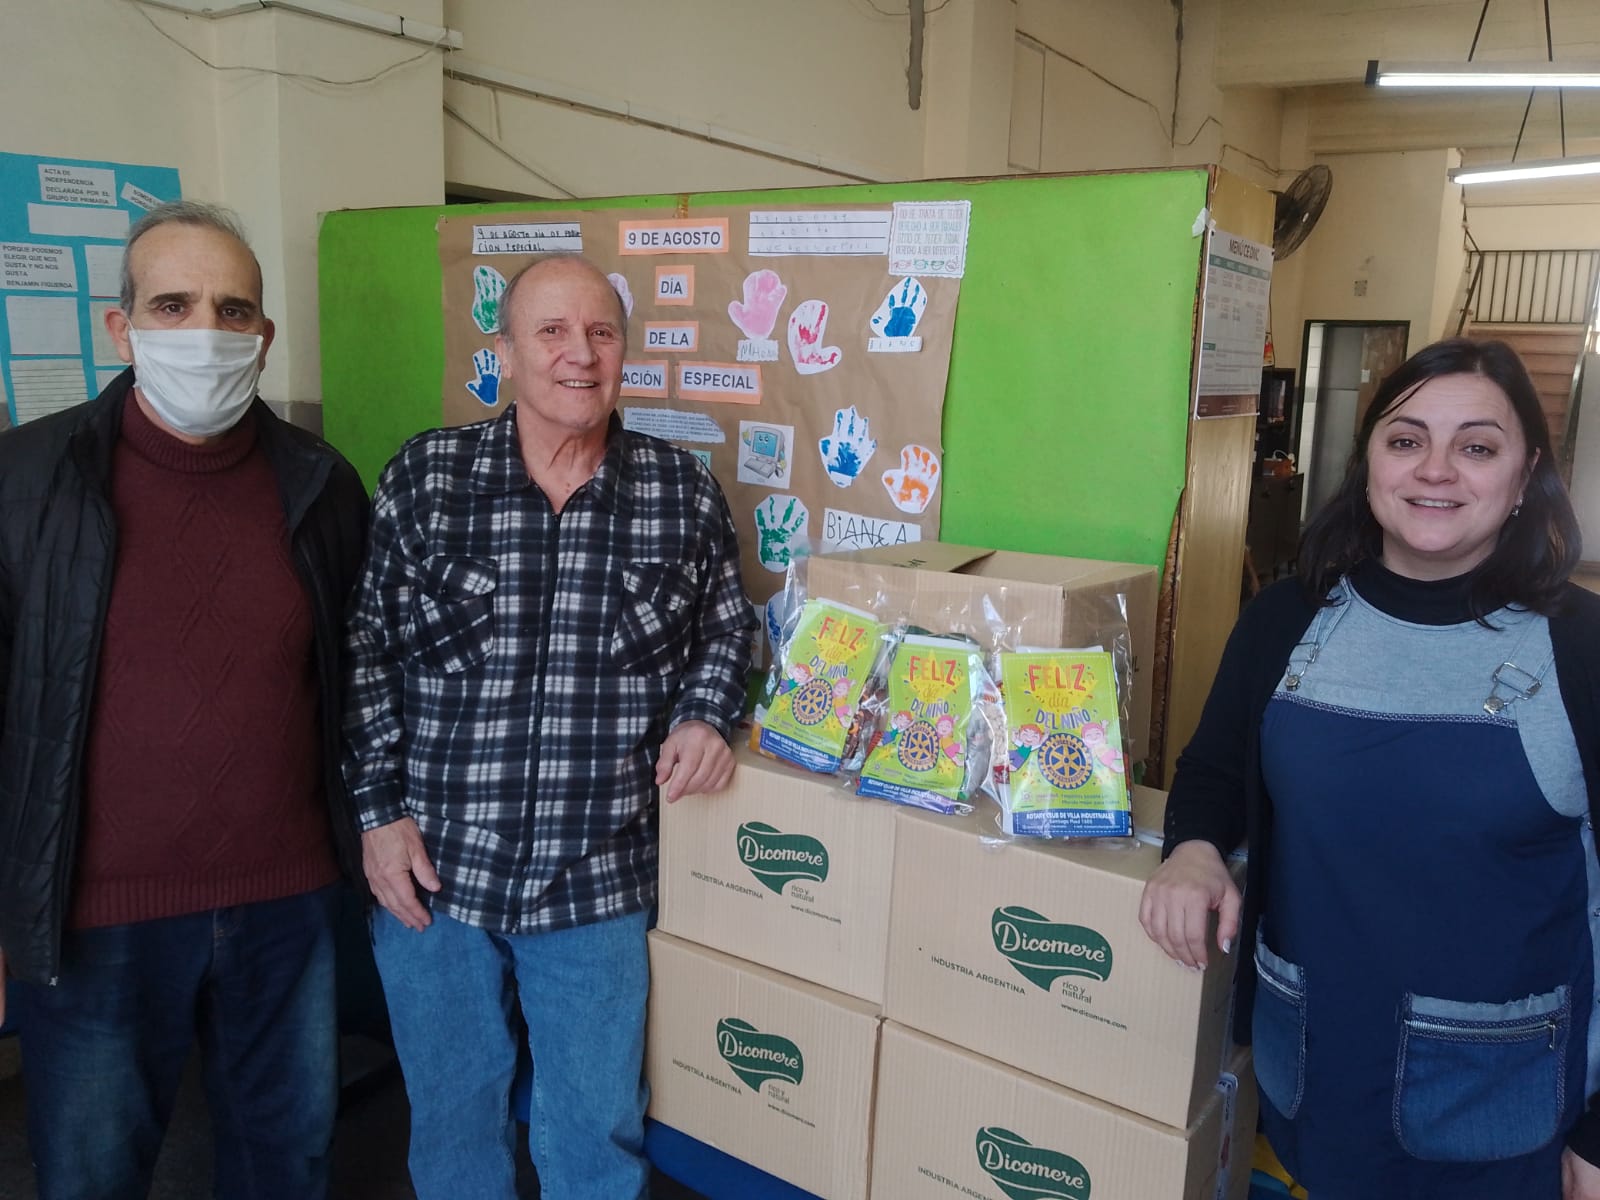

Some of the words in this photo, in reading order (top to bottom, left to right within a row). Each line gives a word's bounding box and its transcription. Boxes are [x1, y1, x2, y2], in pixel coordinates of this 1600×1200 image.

[478, 227, 485, 240] 9
[628, 233, 636, 246] 9
[641, 233, 658, 246] DE
[662, 231, 721, 246] AGOSTO
[660, 278, 683, 295] DÍA
[649, 332, 666, 345] DE
[671, 332, 689, 346] LA
[622, 370, 661, 387] ACIÓN
[684, 371, 754, 389] ESPECIAL
[819, 616, 865, 651] FELIZ
[810, 655, 827, 676] DEL
[828, 662, 848, 679] NIÑO
[909, 656, 956, 686] FELIZ
[1028, 663, 1087, 692] FELIZ
[911, 699, 924, 718] DEL
[925, 698, 949, 718] NIÑO
[1035, 708, 1057, 730] DEL
[1060, 706, 1091, 730] NIÑO
[739, 835, 823, 867] Dicomere
[691, 870, 725, 887] INDUSTRIA
[725, 882, 763, 900] ARGENTINA
[791, 885, 804, 895] rico
[791, 891, 814, 903] natural
[995, 920, 1106, 963] Dicomere
[931, 955, 974, 977] INDUSTRIA
[976, 971, 1026, 996] ARGENTINA
[1062, 981, 1079, 993] rico
[1080, 986, 1086, 995] y
[1062, 988, 1092, 1004] natural
[1061, 1003, 1128, 1031] www.dicomere.com
[718, 1030, 799, 1069] Dicomere
[672, 1058, 705, 1079] INDUSTRIA
[706, 1073, 742, 1096] ARGENTINA
[768, 1090, 790, 1105] natural
[979, 1140, 1084, 1189] Dicomere
[918, 1165, 960, 1189] INDUSTRIA
